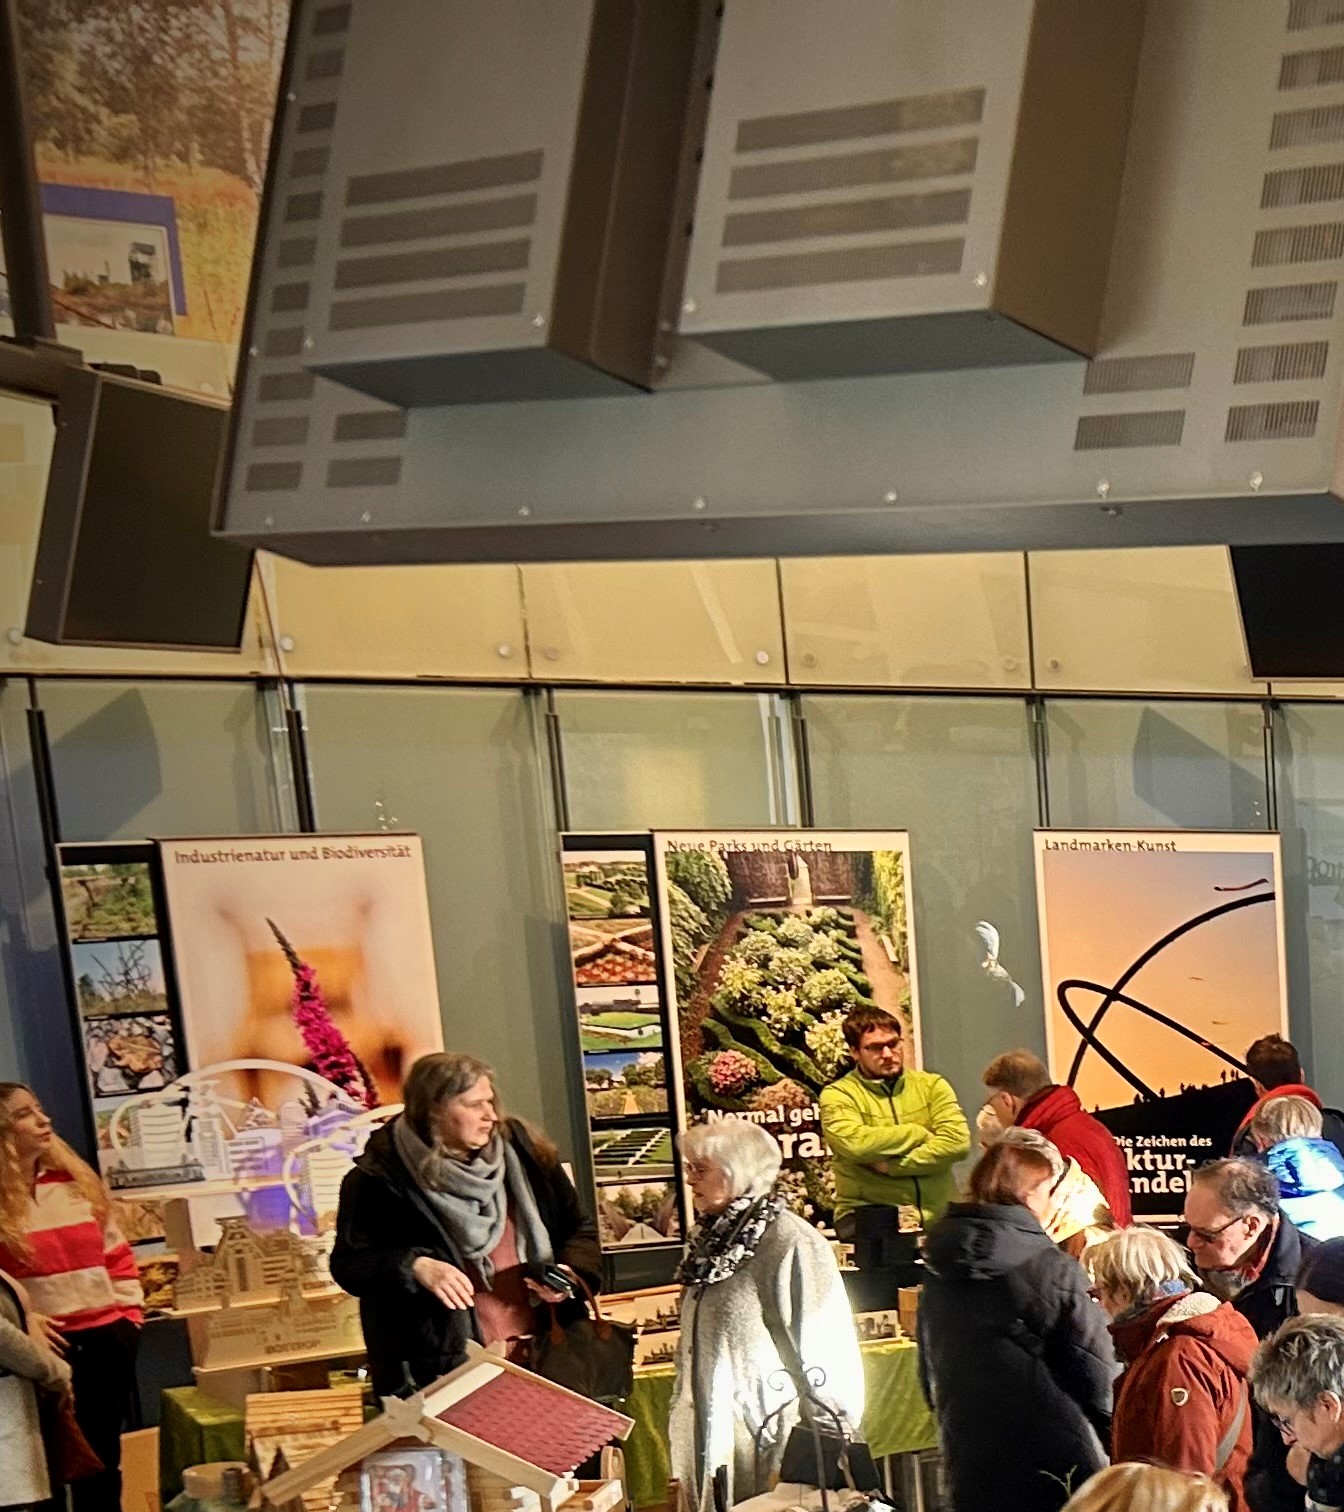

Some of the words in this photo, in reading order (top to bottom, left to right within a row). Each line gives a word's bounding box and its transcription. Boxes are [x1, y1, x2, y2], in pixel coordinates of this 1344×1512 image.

[667, 840, 705, 852] Neue
[709, 839, 747, 852] Parks
[751, 839, 779, 852] und
[784, 839, 832, 852] Gärten
[1045, 839, 1177, 852] Landmarken-Kunst
[174, 848, 286, 864] Industrienatur
[289, 847, 318, 861] und
[322, 845, 412, 860] Biodiversität
[1135, 1135, 1187, 1147] Zeichen
[1189, 1134, 1213, 1147] des
[1124, 1148, 1196, 1171] ktur-
[1128, 1170, 1192, 1194] ndel
